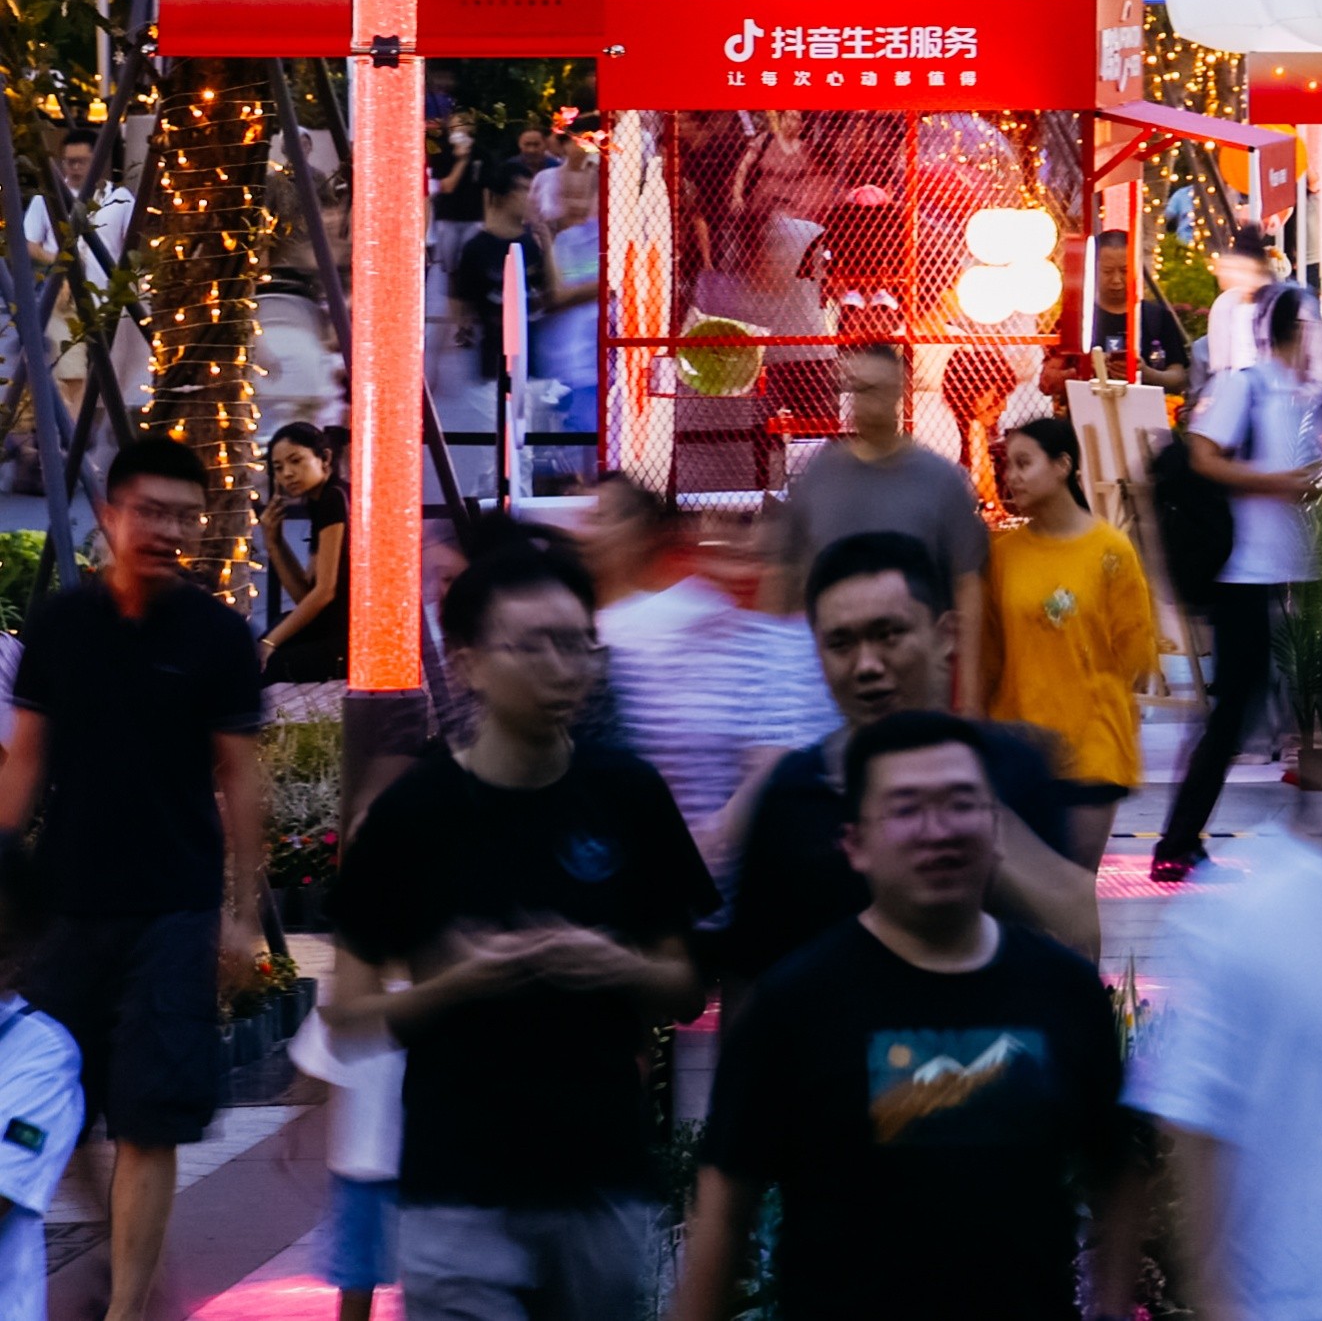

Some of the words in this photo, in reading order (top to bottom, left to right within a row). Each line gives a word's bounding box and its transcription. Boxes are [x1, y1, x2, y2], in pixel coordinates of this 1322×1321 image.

[771, 26, 978, 59] 抖音生活服务
